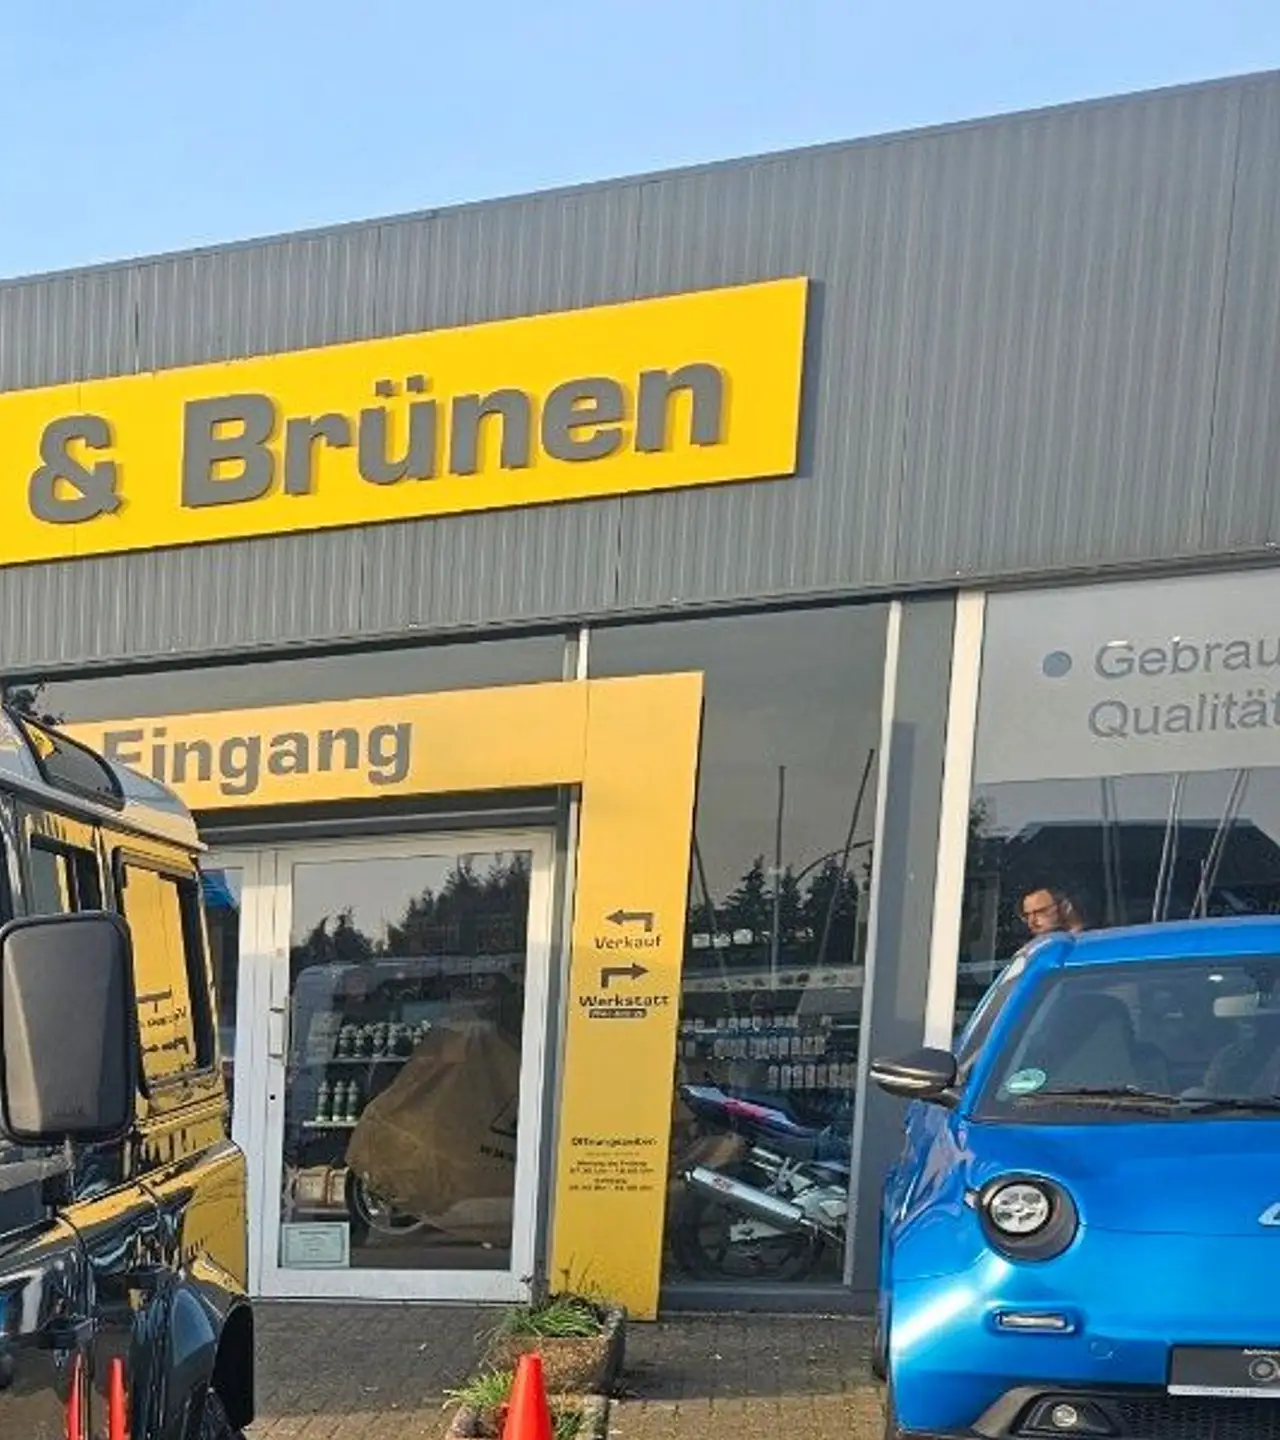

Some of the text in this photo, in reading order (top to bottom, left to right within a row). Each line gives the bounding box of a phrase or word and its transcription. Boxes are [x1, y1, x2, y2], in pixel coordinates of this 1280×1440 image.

[28, 413, 124, 525] &
[180, 360, 725, 511] Brünen
[1094, 636, 1280, 680] Gebrau
[103, 721, 413, 796] Eingang
[593, 935, 662, 950] Verkauf
[578, 993, 670, 1008] Werkstatt
